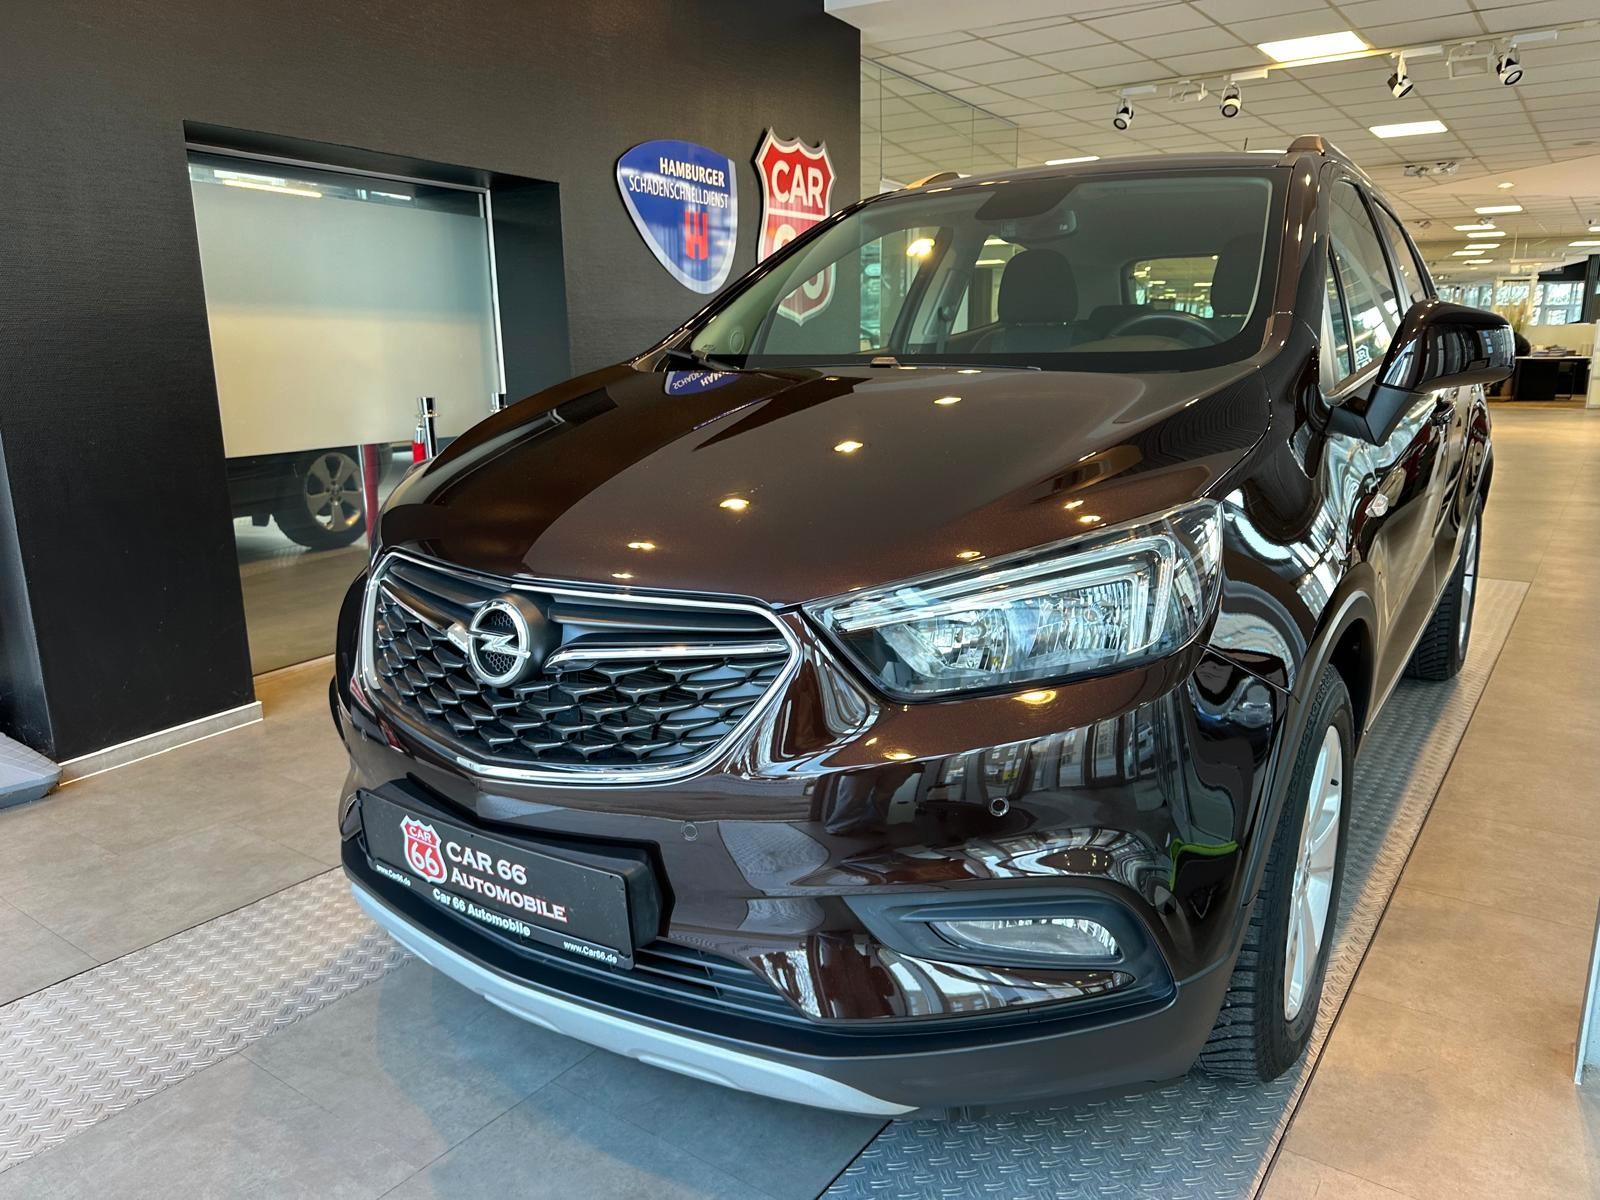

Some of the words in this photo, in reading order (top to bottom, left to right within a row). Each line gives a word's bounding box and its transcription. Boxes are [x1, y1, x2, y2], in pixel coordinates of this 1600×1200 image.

[660, 157, 725, 188] HAMBURGER
[771, 160, 824, 209] CAR
[629, 175, 729, 209] SCHADENSCHNELLDIENST
[409, 826, 433, 843] CAR
[411, 841, 440, 876] 66
[446, 841, 494, 875] CAR
[497, 859, 528, 886] 66
[432, 888, 451, 905] Car
[453, 897, 466, 913] 66
[467, 903, 531, 937] Automobile
[451, 867, 568, 923] AUTOMOBILE
[563, 941, 618, 965] www.Car66.de
